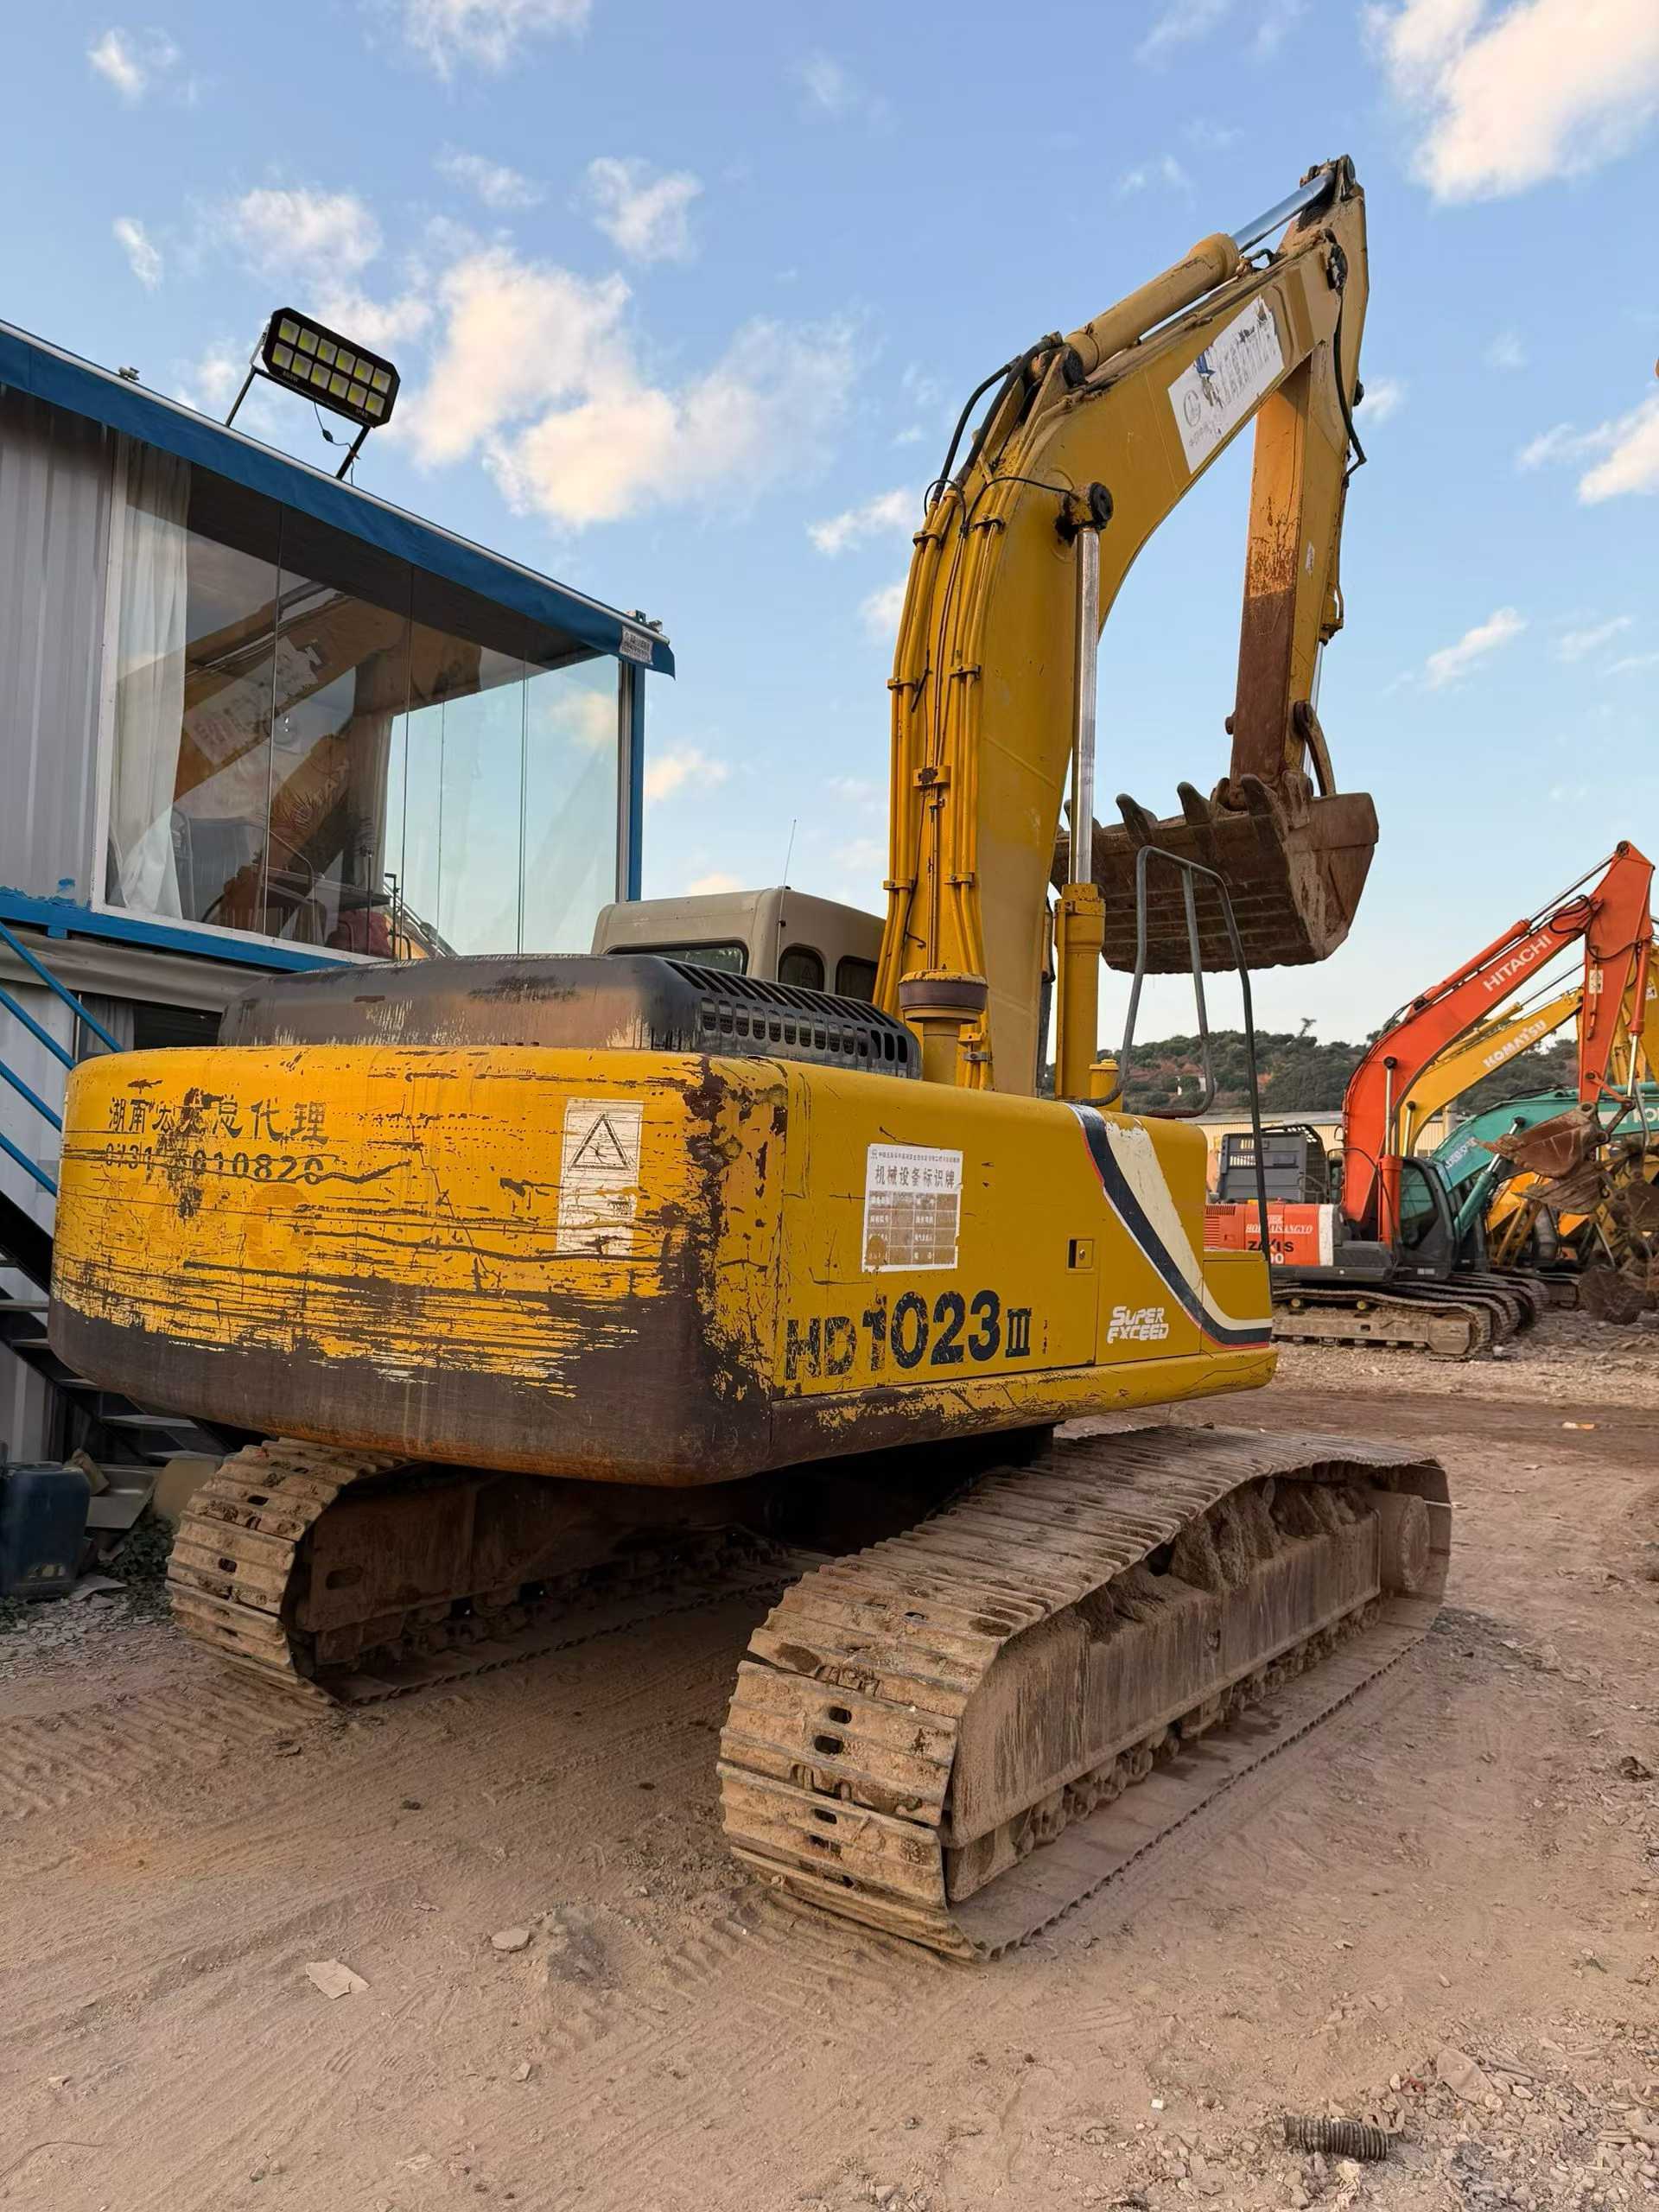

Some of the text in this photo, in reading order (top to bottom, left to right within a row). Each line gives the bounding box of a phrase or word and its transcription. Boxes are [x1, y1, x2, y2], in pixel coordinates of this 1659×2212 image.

[1483, 935, 1553, 991] HITACHI
[1483, 1020, 1547, 1068] KOMATSU
[874, 1164, 955, 1189] 机械设备标识牌
